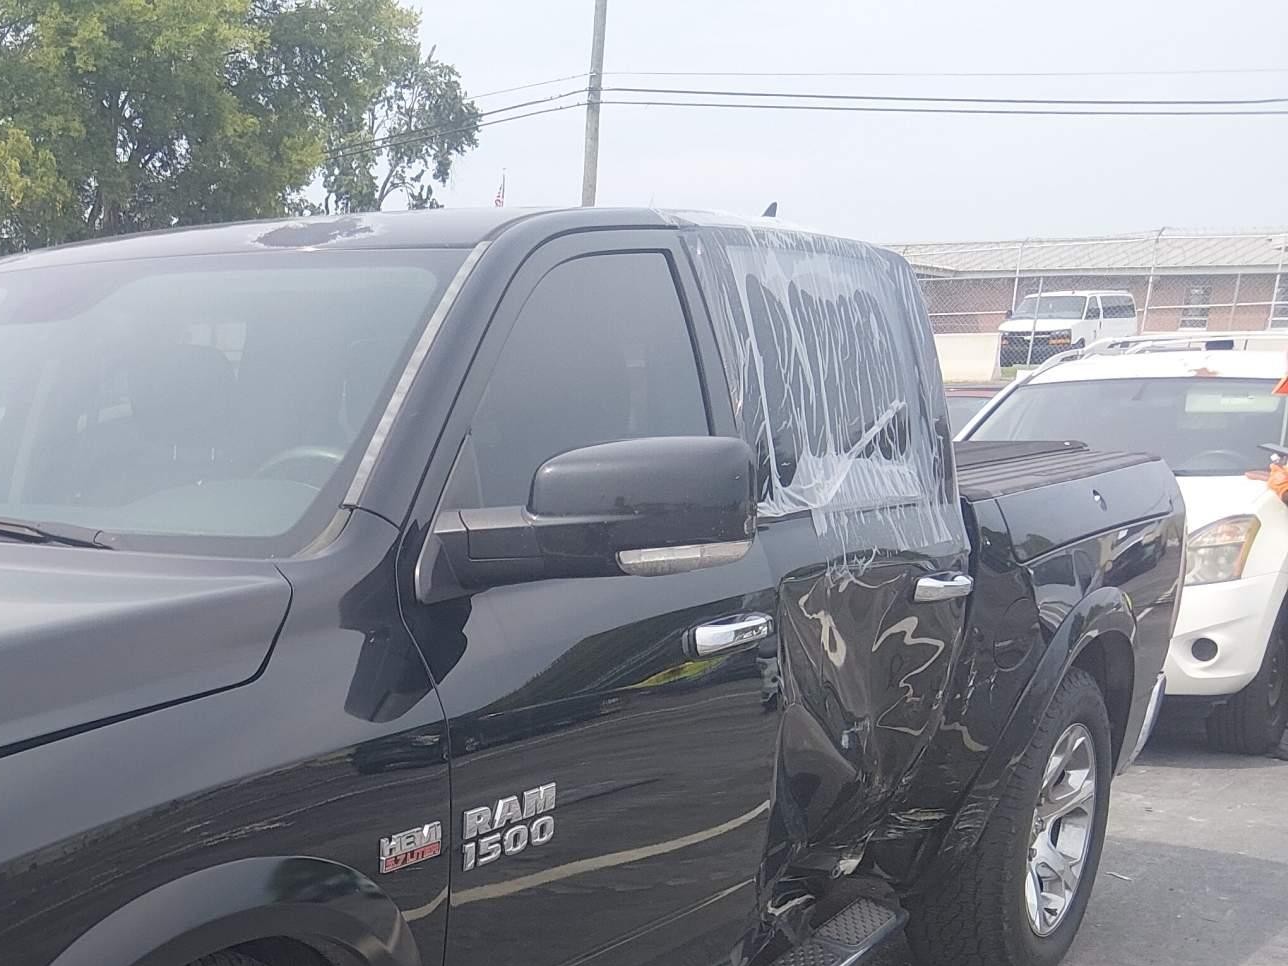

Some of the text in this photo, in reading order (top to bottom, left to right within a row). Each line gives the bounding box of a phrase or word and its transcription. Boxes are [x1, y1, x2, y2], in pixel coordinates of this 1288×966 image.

[463, 782, 556, 840] RAM
[380, 821, 441, 858] HEMI
[462, 816, 555, 872] 1500
